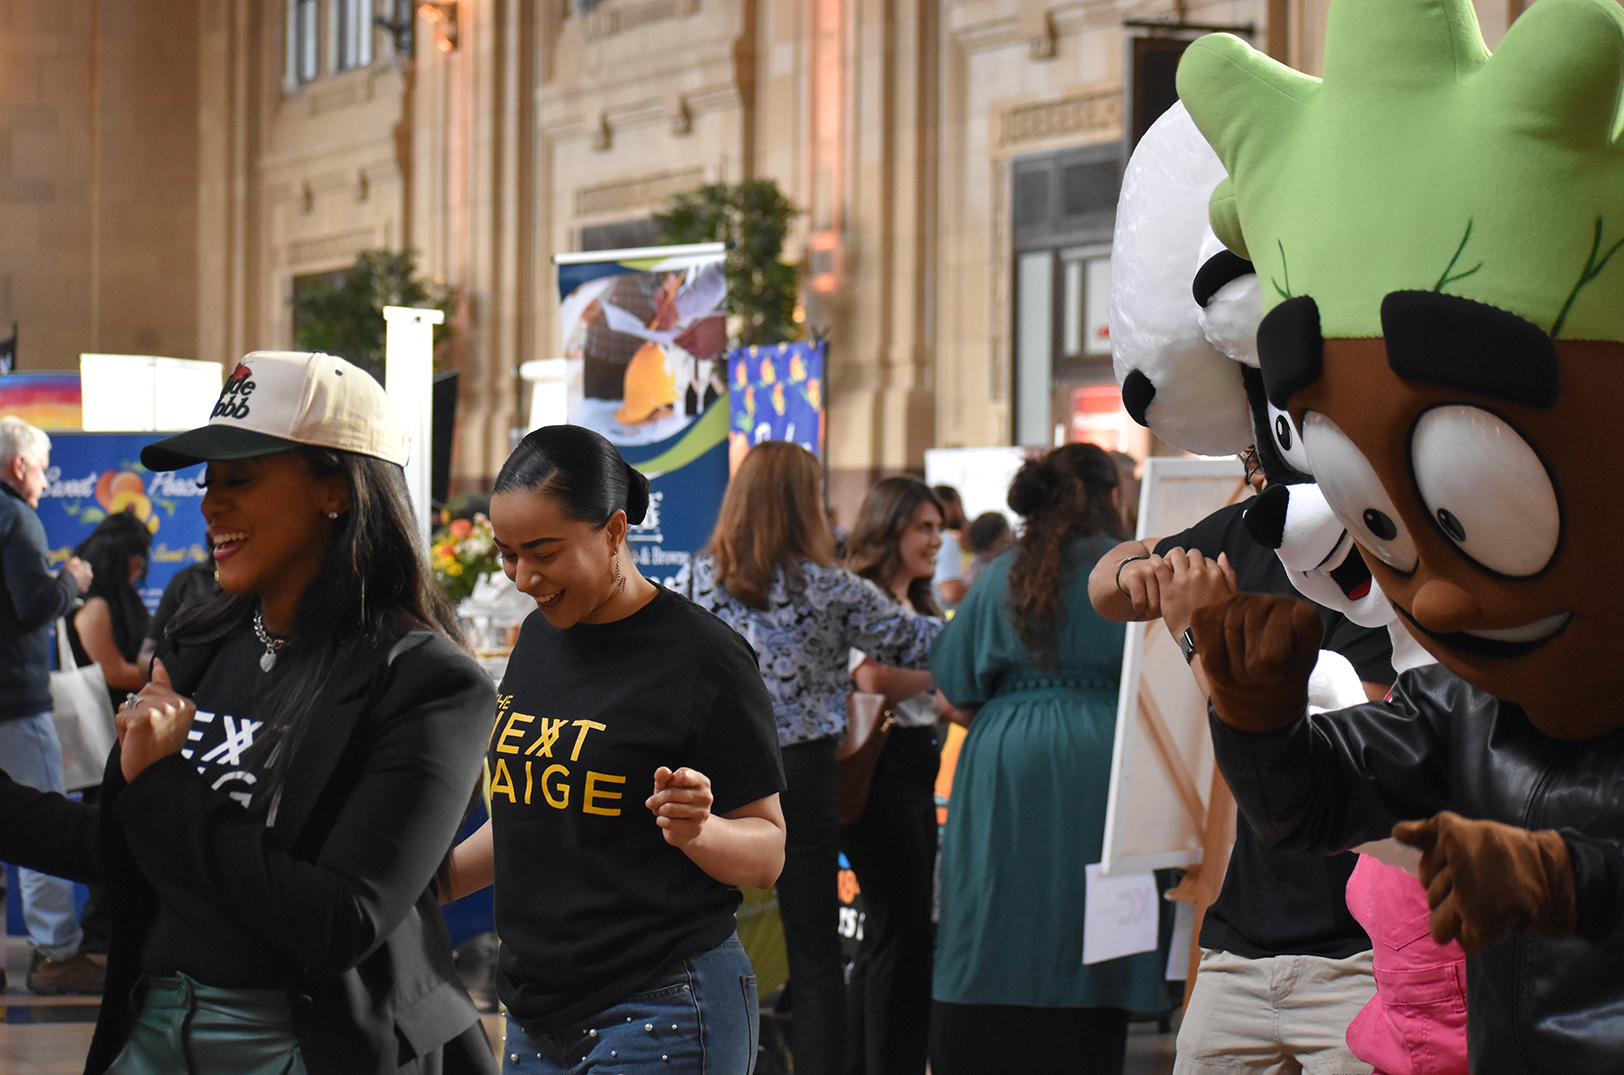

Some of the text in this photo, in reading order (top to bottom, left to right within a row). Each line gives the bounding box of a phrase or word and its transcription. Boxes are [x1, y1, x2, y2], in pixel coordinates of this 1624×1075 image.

[497, 693, 514, 710] HE
[487, 711, 608, 762] EXT
[490, 758, 627, 817] AIGE
